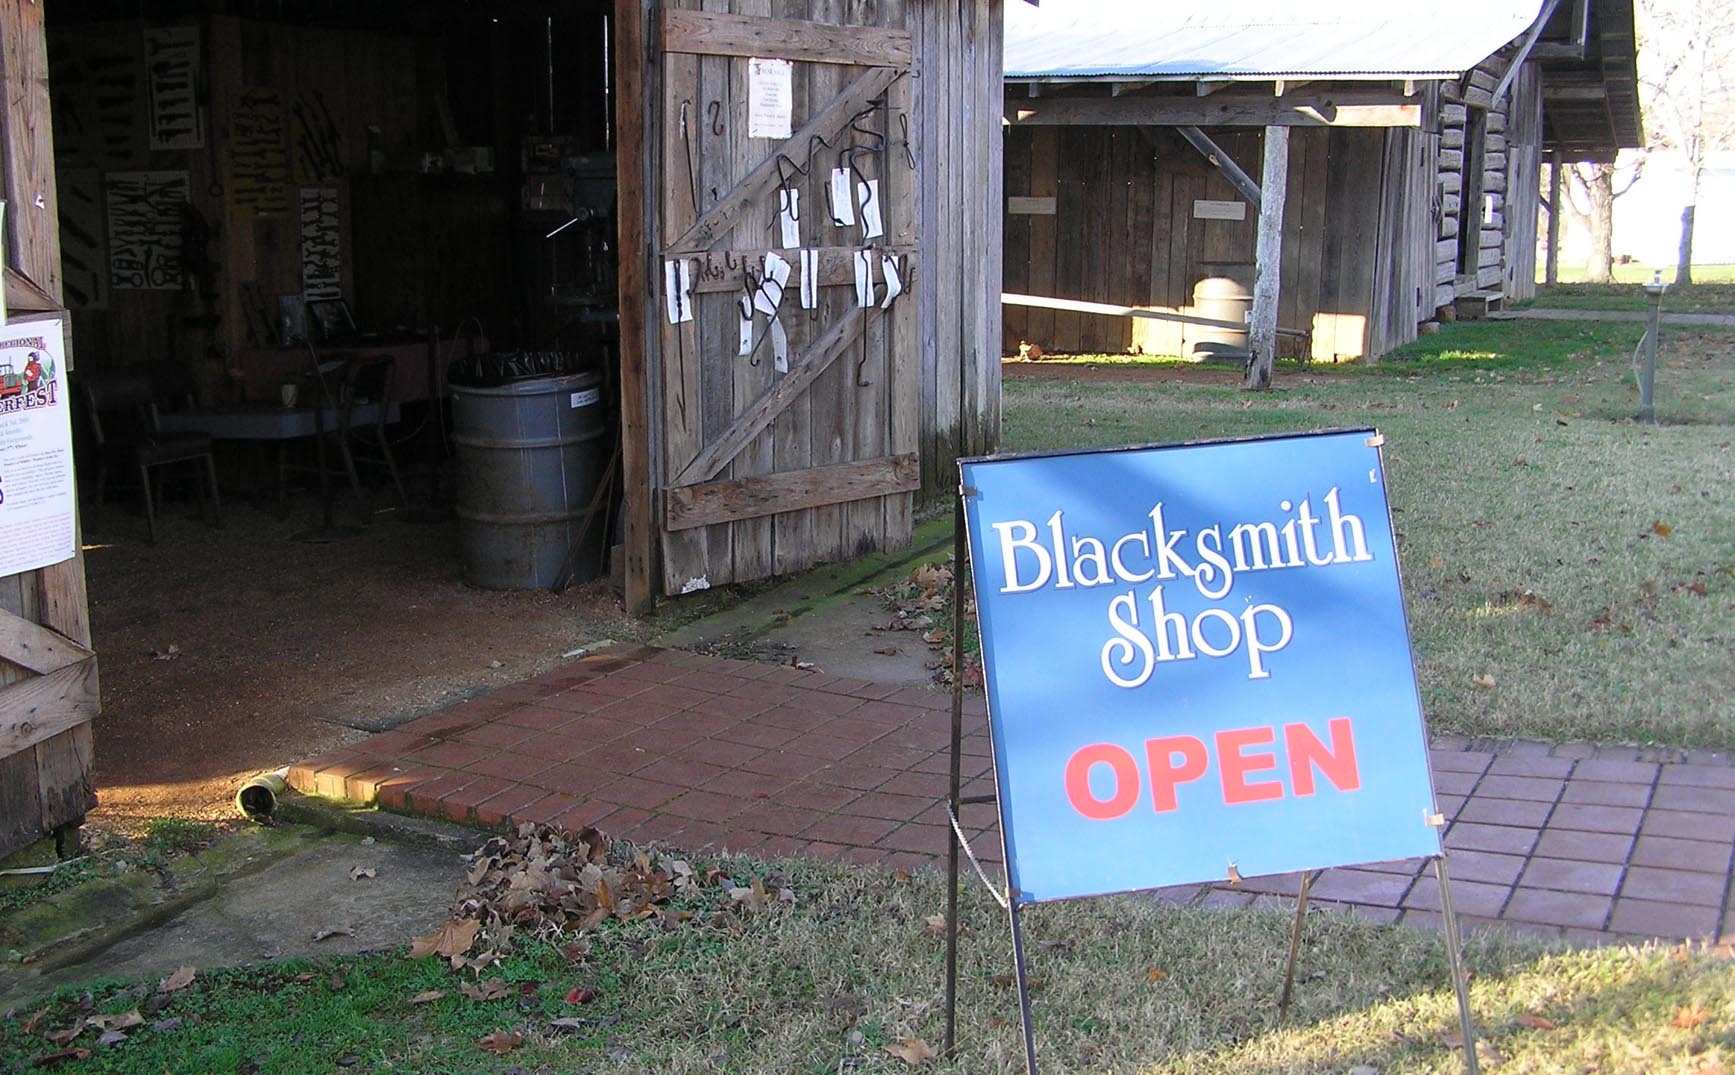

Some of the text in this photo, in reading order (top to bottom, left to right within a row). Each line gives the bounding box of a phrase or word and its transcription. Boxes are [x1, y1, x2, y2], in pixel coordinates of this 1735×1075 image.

[993, 487, 1374, 599] Blacksmith
[1100, 585, 1293, 687] Shop
[1064, 717, 1361, 819] OPEN
